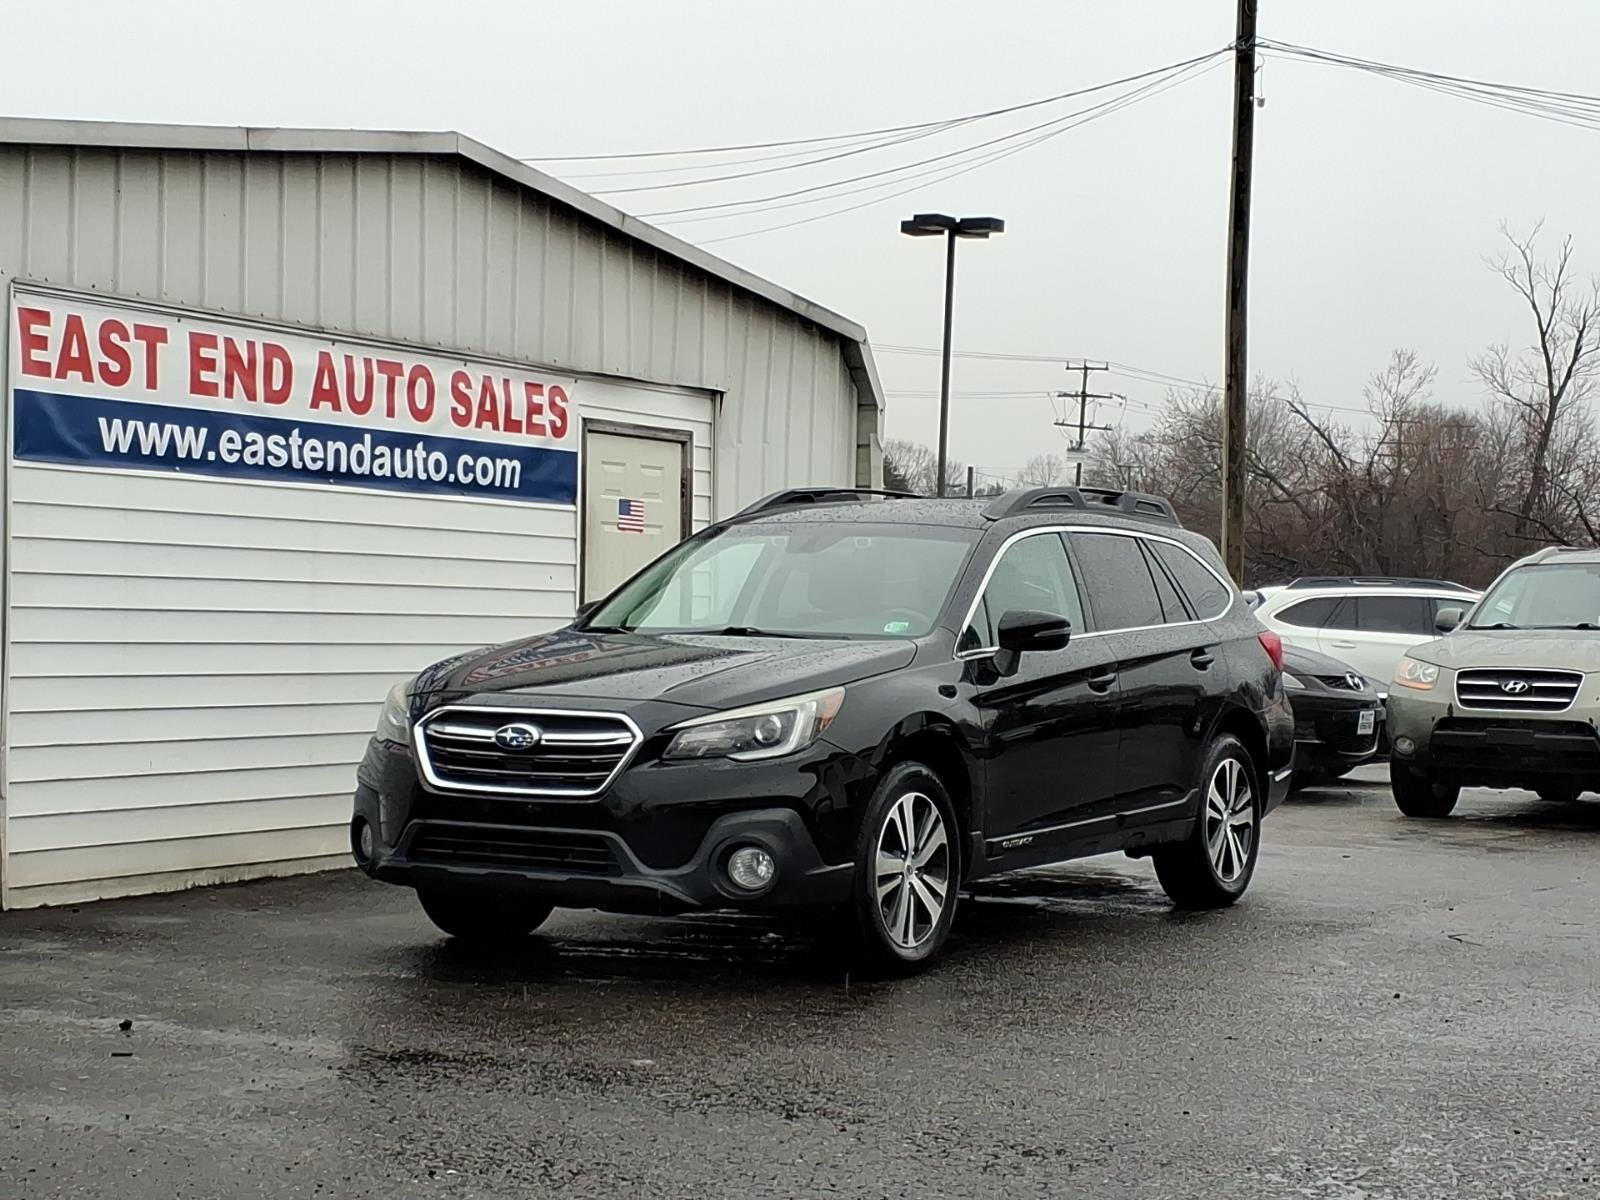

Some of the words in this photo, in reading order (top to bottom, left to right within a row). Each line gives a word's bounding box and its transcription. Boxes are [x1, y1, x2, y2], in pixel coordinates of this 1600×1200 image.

[17, 307, 168, 390] EAST
[189, 331, 294, 405] END
[310, 351, 436, 423] AUTO
[450, 371, 569, 439] SALES
[97, 415, 522, 489] www.eastendauto.com
